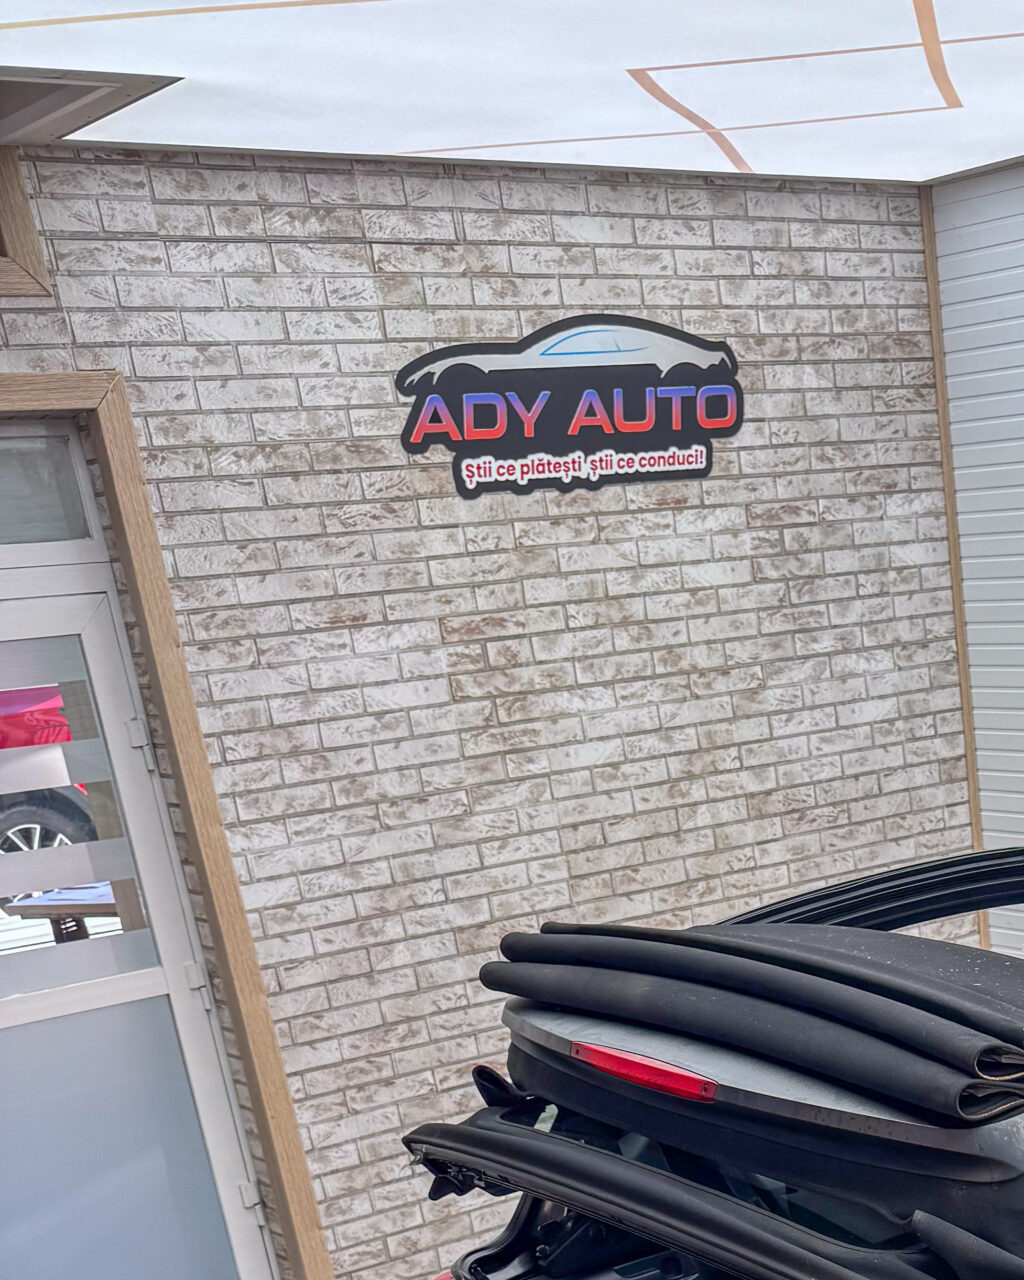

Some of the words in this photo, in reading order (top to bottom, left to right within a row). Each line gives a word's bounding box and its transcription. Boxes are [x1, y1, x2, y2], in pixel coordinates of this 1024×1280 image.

[410, 391, 551, 443] ADY
[567, 384, 738, 435] AUTO
[464, 460, 493, 485] Știi
[496, 463, 516, 477] ce
[616, 457, 635, 469] ce
[638, 449, 704, 468] conduci!
